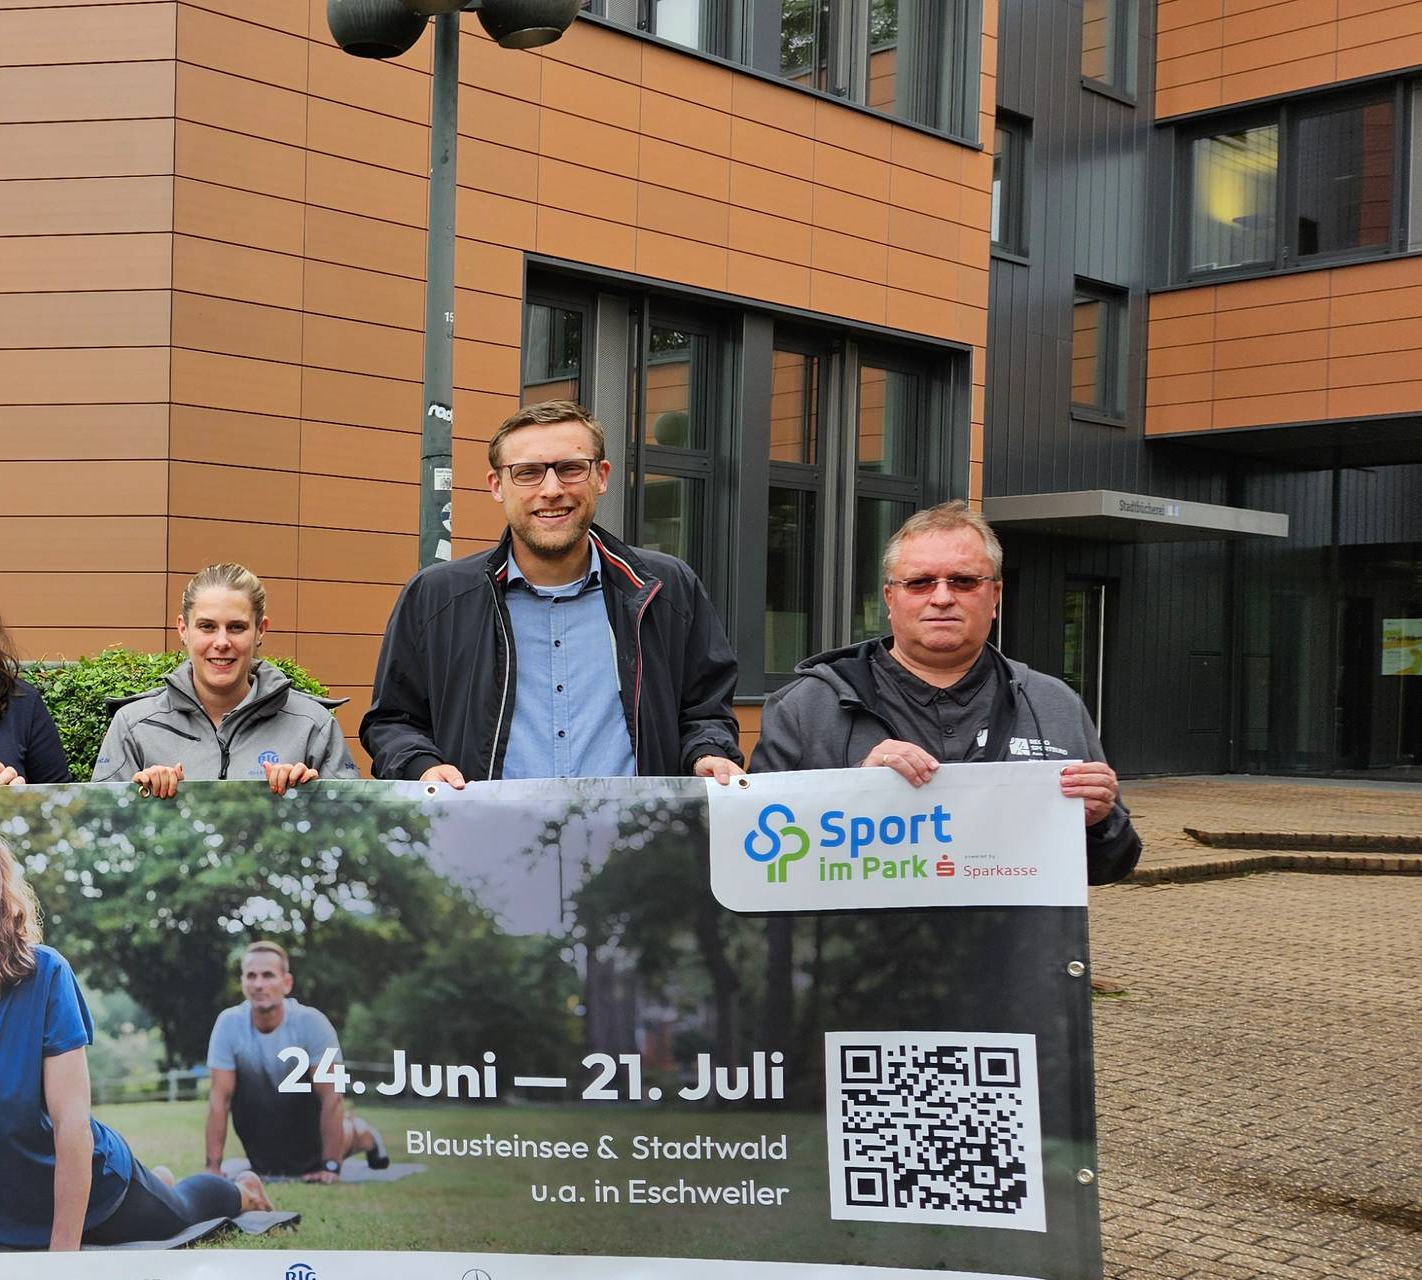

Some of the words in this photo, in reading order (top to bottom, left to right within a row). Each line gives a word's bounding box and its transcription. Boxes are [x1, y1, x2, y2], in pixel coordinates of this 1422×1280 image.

[820, 804, 953, 858] Sport
[819, 858, 853, 882] im
[862, 854, 928, 881] Park
[963, 864, 1038, 879] Sparkasse
[277, 1045, 366, 1094] 24.
[375, 1048, 497, 1099] Juni
[581, 1052, 662, 1102] 21.
[678, 1050, 785, 1101] Juli
[406, 1129, 590, 1160] Blausteinsee
[597, 1134, 615, 1160] &
[631, 1133, 788, 1161] Stadtwald
[531, 1182, 586, 1205] u.a.
[594, 1178, 619, 1204] in
[629, 1178, 790, 1207] Eschweiler
